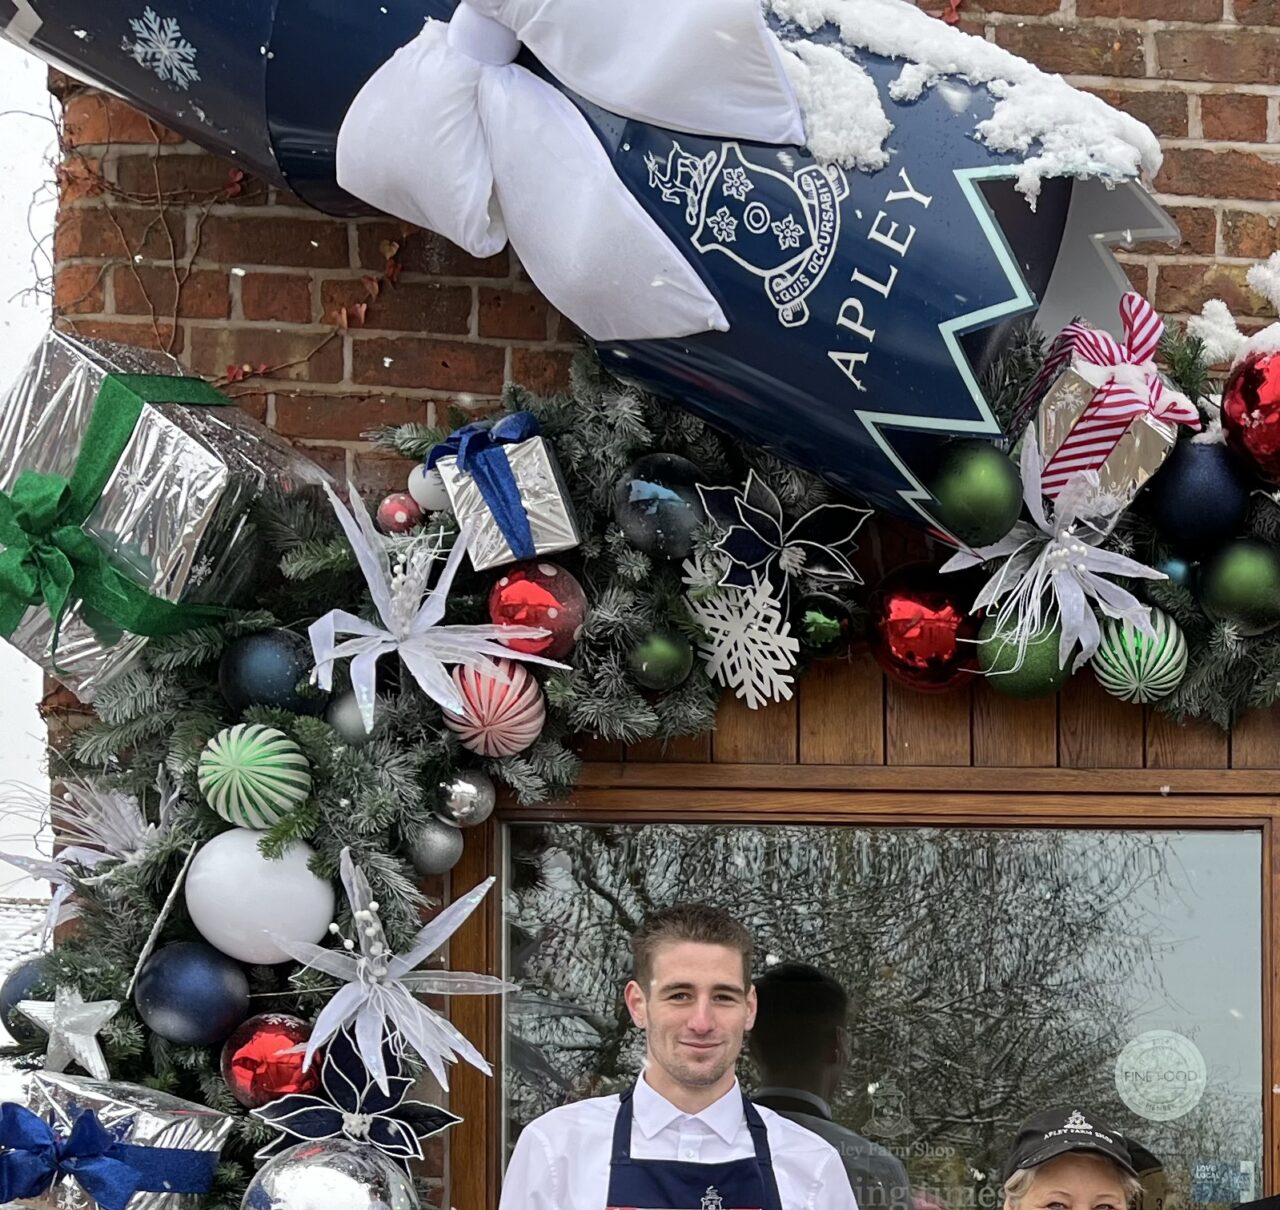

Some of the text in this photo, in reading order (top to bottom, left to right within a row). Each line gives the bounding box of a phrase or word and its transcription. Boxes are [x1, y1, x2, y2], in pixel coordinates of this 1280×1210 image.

[778, 178, 834, 302] QUIS OCCURSABIT
[827, 167, 933, 392] APLEY
[914, 1141, 956, 1161] Shop
